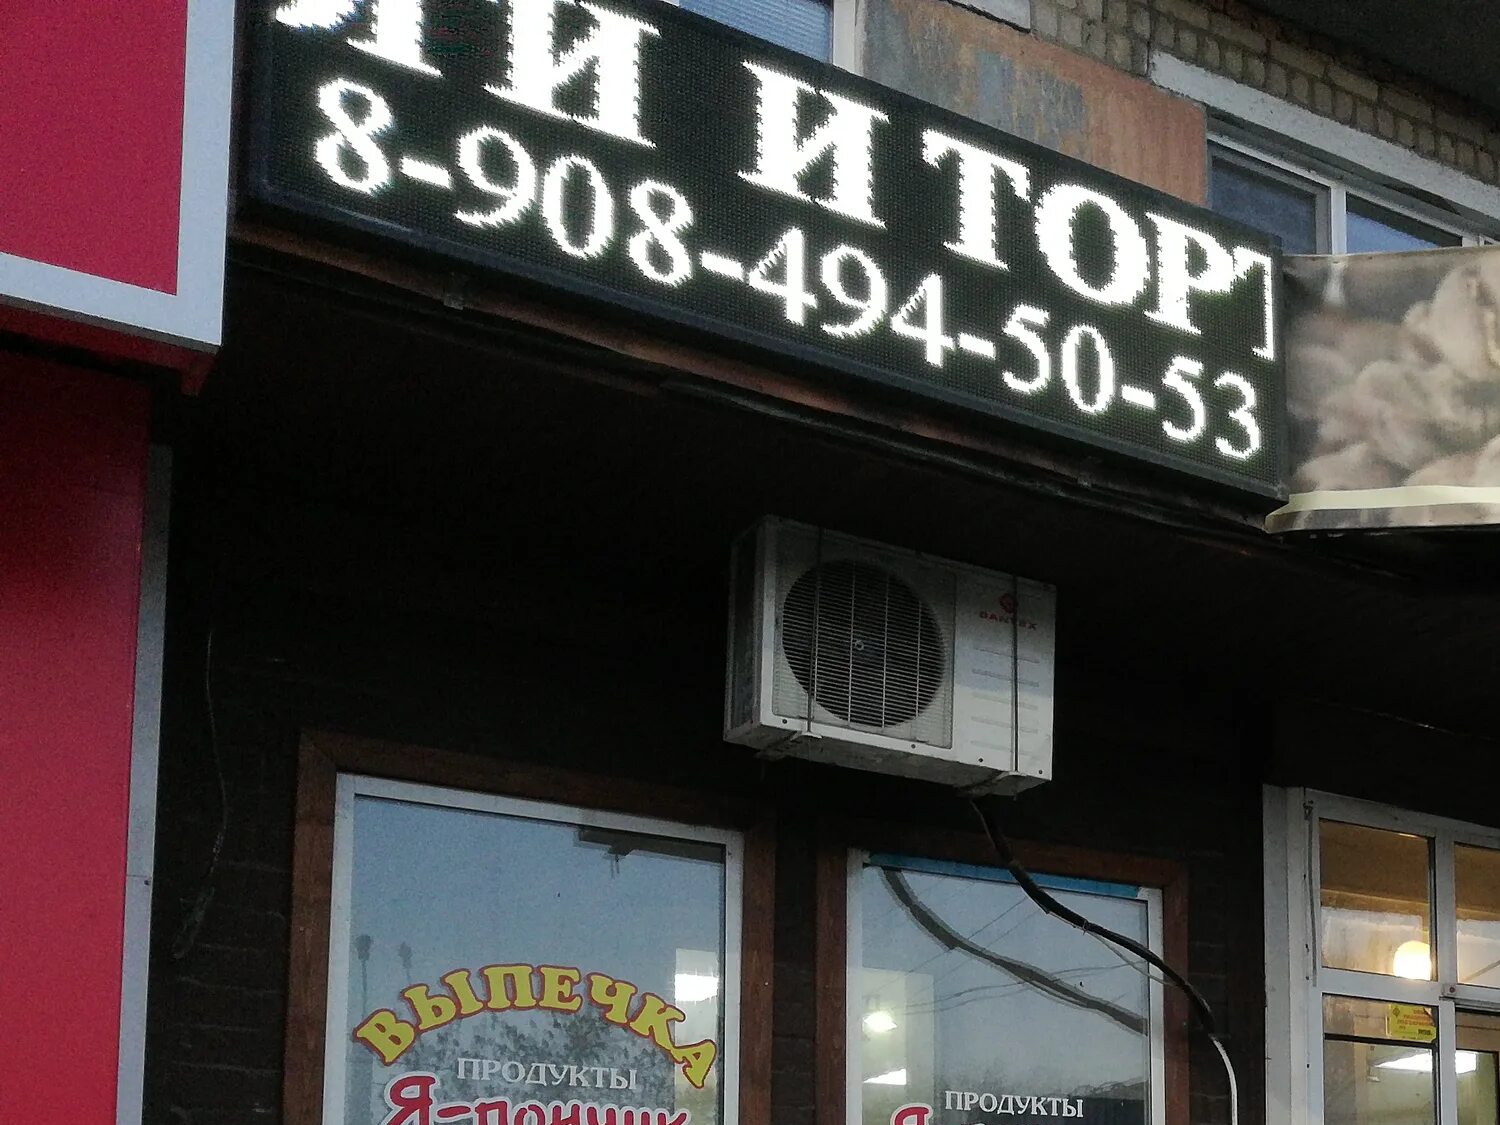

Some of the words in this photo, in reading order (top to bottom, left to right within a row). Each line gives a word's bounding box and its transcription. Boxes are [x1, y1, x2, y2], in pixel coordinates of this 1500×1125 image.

[739, 56, 890, 230] И
[313, 78, 1262, 461] 8-908-494-50-53
[353, 963, 717, 1089] ВЫПЕЧКА
[456, 1057, 637, 1091] ПРОДУКТЫ
[944, 1090, 1084, 1118] ПРОДУКТЫ
